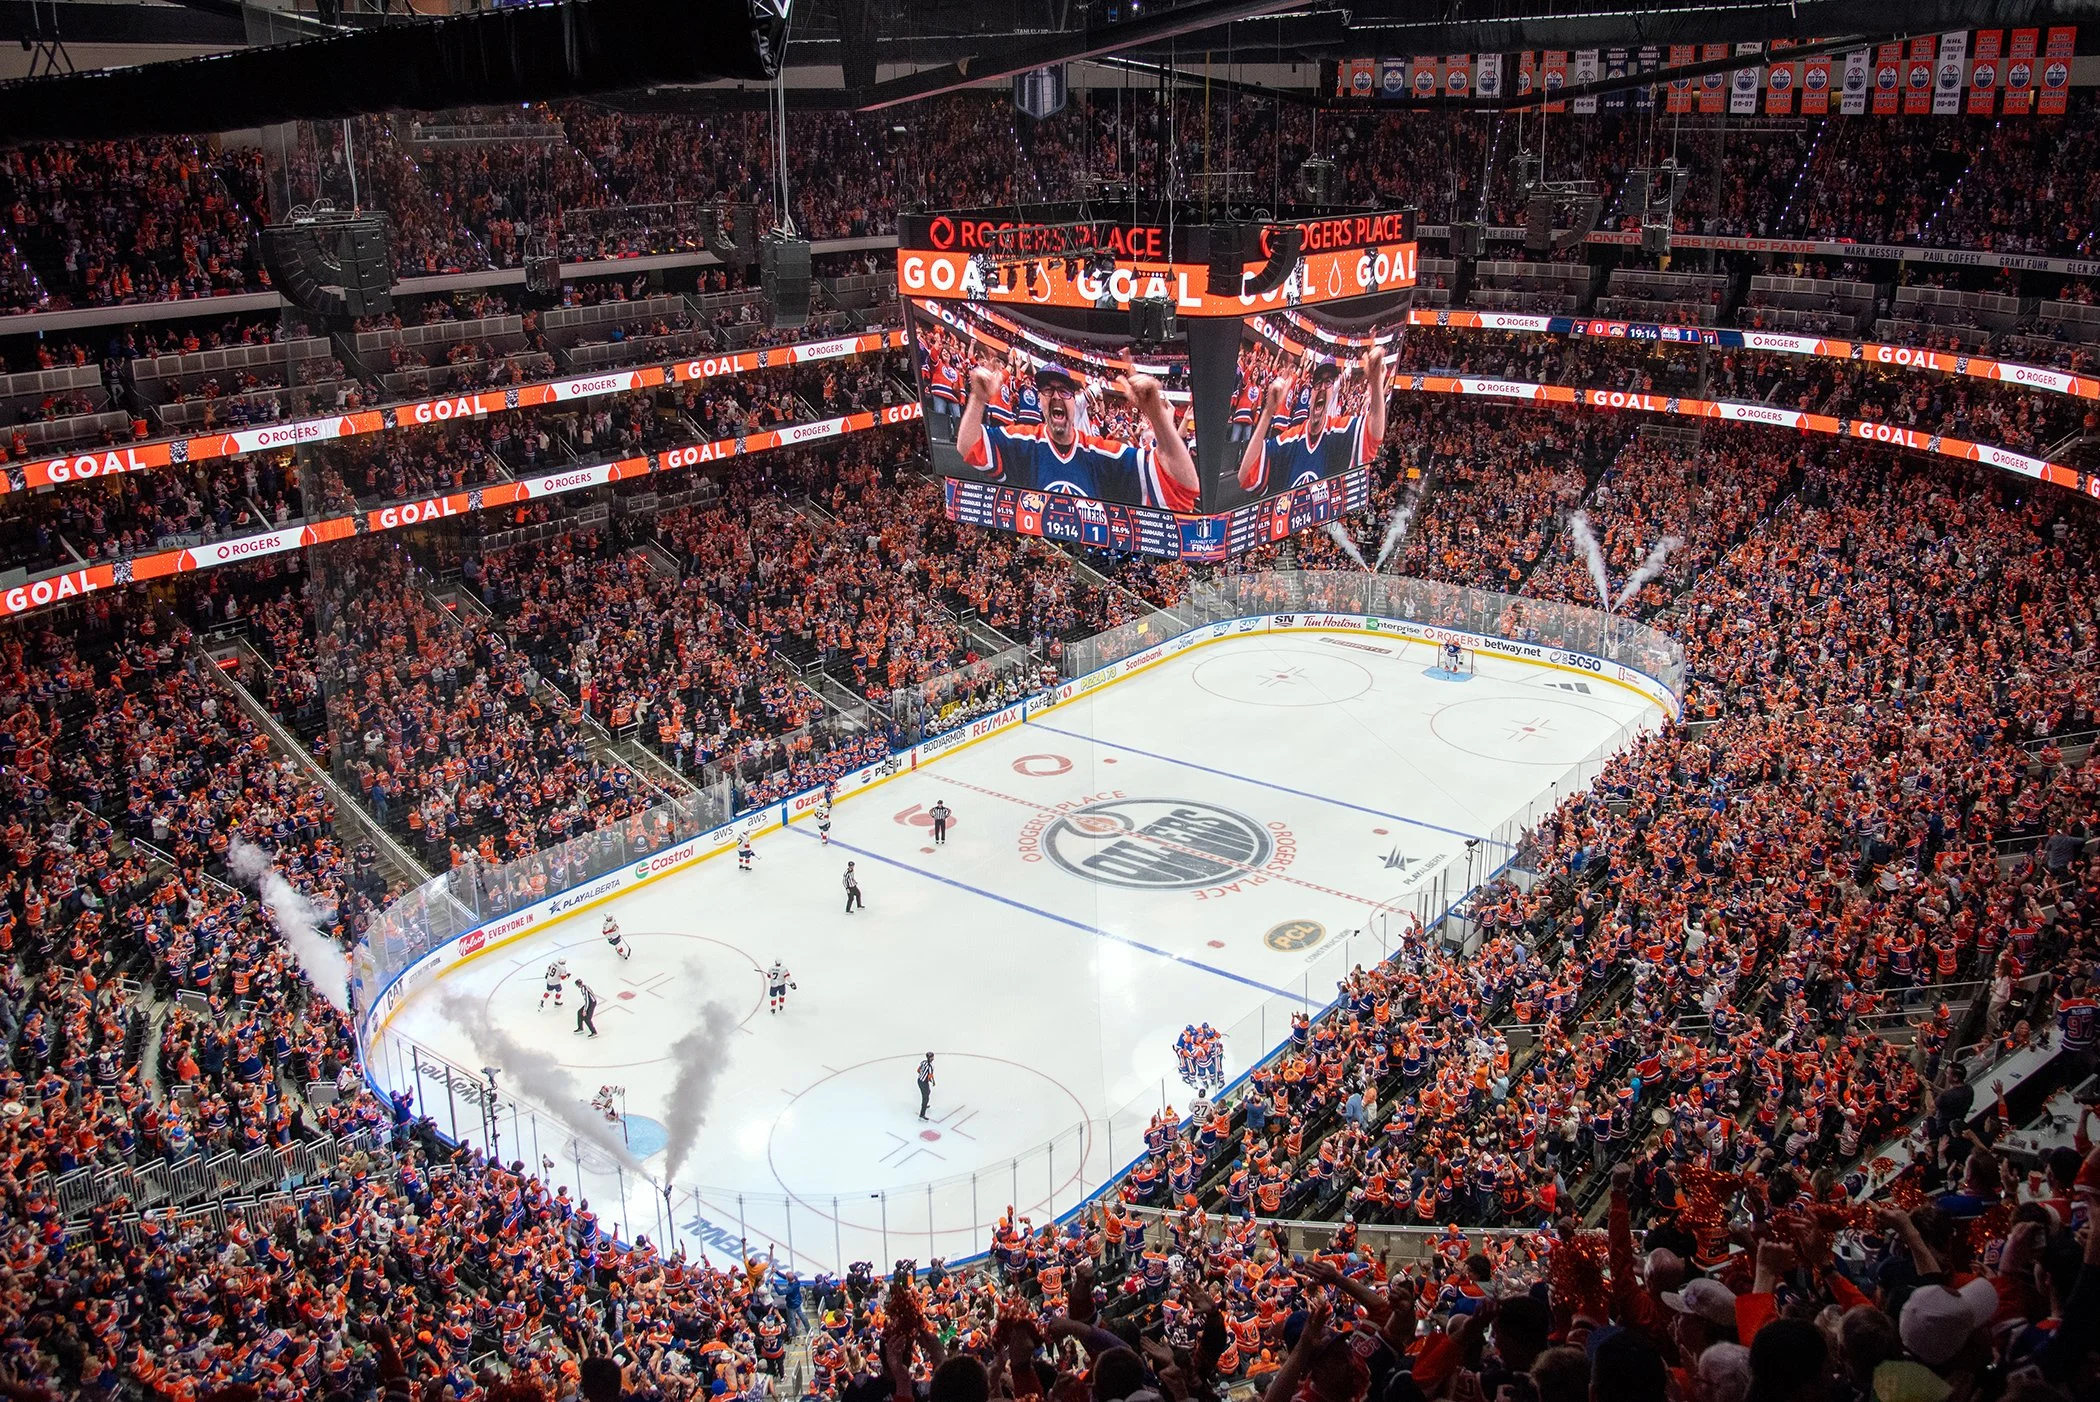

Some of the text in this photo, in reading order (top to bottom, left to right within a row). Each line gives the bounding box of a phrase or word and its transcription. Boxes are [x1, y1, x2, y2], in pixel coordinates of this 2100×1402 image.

[1295, 215, 1402, 251] OGERS PLACE
[1704, 239, 1816, 252] HALL OF FAME
[1844, 246, 1905, 259] MARK MESSIER
[1923, 251, 1982, 264] PAUL COFFEY
[2000, 257, 2049, 270] GRANT FUHR
[1356, 249, 1417, 288] GOAL
[2067, 262, 2089, 273] GLEN
[1077, 267, 1202, 308] GOAL
[924, 300, 977, 339] GOAL
[1506, 317, 1540, 328] ROGERS
[1253, 316, 1285, 348] GOAL
[1594, 323, 1603, 334] 0
[1629, 328, 1658, 340] 19:14
[1686, 330, 1692, 341] 1
[1703, 335, 1714, 344] 11
[816, 343, 844, 356] ROGERS
[687, 355, 744, 380] GOAL
[1082, 354, 1109, 367] GOAL
[1763, 337, 2057, 387] ROGERS GOAL ROGERS
[582, 378, 617, 393] ROGERS
[1487, 383, 1520, 394] ROGERS
[414, 395, 488, 424] GOAL
[1593, 391, 1655, 411] GOAL
[1747, 409, 1783, 422] ROGERS
[272, 425, 319, 443] ROGERS
[802, 424, 831, 437] ROGERS
[1858, 421, 1918, 448] GOAL
[667, 442, 726, 469] GOAL
[2001, 453, 2029, 471] ROGERS
[46, 449, 146, 483] GOAL
[554, 472, 592, 488] ROGERS
[380, 497, 457, 529] GOAL
[1319, 504, 1324, 519] 1
[1023, 515, 1034, 530] 0
[1276, 519, 1283, 534] 0
[1291, 512, 1311, 529] 19:14
[1046, 521, 1078, 538] 19:14
[1092, 526, 1099, 542] 1
[232, 536, 281, 555] ROGERS
[1191, 543, 1215, 551] FINAL
[5, 569, 97, 612] GOAL
[1240, 619, 1256, 630] SAP
[1274, 615, 1295, 624] SN
[1303, 615, 1361, 629] Tim Hortons
[1372, 620, 1420, 635] enterprise
[1213, 624, 1228, 636] SAP
[1437, 630, 1480, 646] ROGERS
[1484, 638, 1541, 658] betway.net
[1126, 648, 1163, 671] Scotiabank
[1080, 666, 1117, 691] PIZZA 73
[973, 708, 1016, 737] RE/MAX
[923, 729, 966, 754] BODYARMOR
[747, 812, 768, 827] aws
[1019, 790, 1127, 853] ROGERS PLACE
[713, 825, 734, 842] aws
[651, 845, 694, 872] Castrol
[1195, 830, 1297, 901] ROGERS PLACE
[1403, 853, 1448, 886] PLAYALBERTA
[563, 878, 621, 910] PLAYALBERTA
[488, 914, 534, 940] EVERYONE IN
[456, 934, 486, 957] Molson
[1274, 924, 1317, 950] PCL
[1304, 928, 1353, 963] CONSTRUCTION
[772, 971, 779, 981] 7
[387, 978, 404, 1011] CAT
[2067, 1016, 2093, 1038] 97
[99, 1063, 115, 1073] 94
[1194, 1105, 1208, 1117] 27
[1503, 1192, 1518, 1203] 97
[1045, 1273, 1061, 1285] 97
[1242, 1329, 1258, 1340] 44
